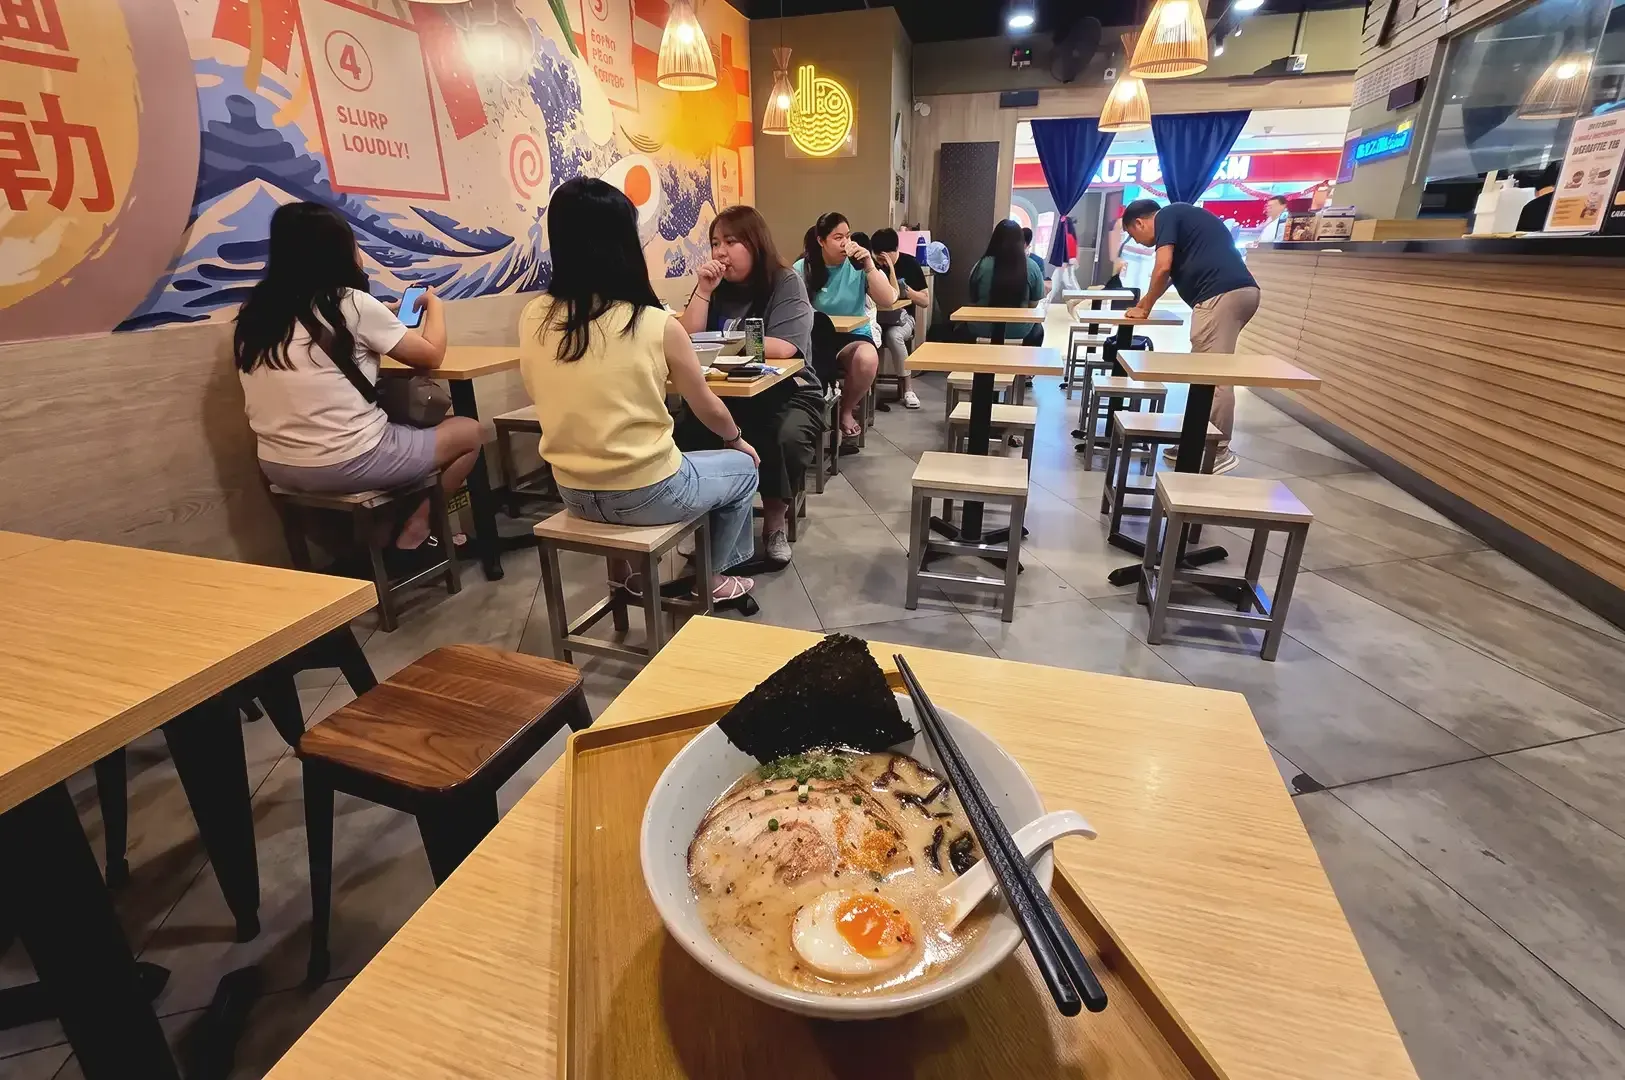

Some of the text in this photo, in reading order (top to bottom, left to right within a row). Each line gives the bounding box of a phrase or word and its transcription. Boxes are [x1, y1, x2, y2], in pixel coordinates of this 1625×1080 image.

[340, 44, 361, 80] 4
[336, 105, 388, 130] SLURP
[342, 133, 410, 160] LOUDLY!
